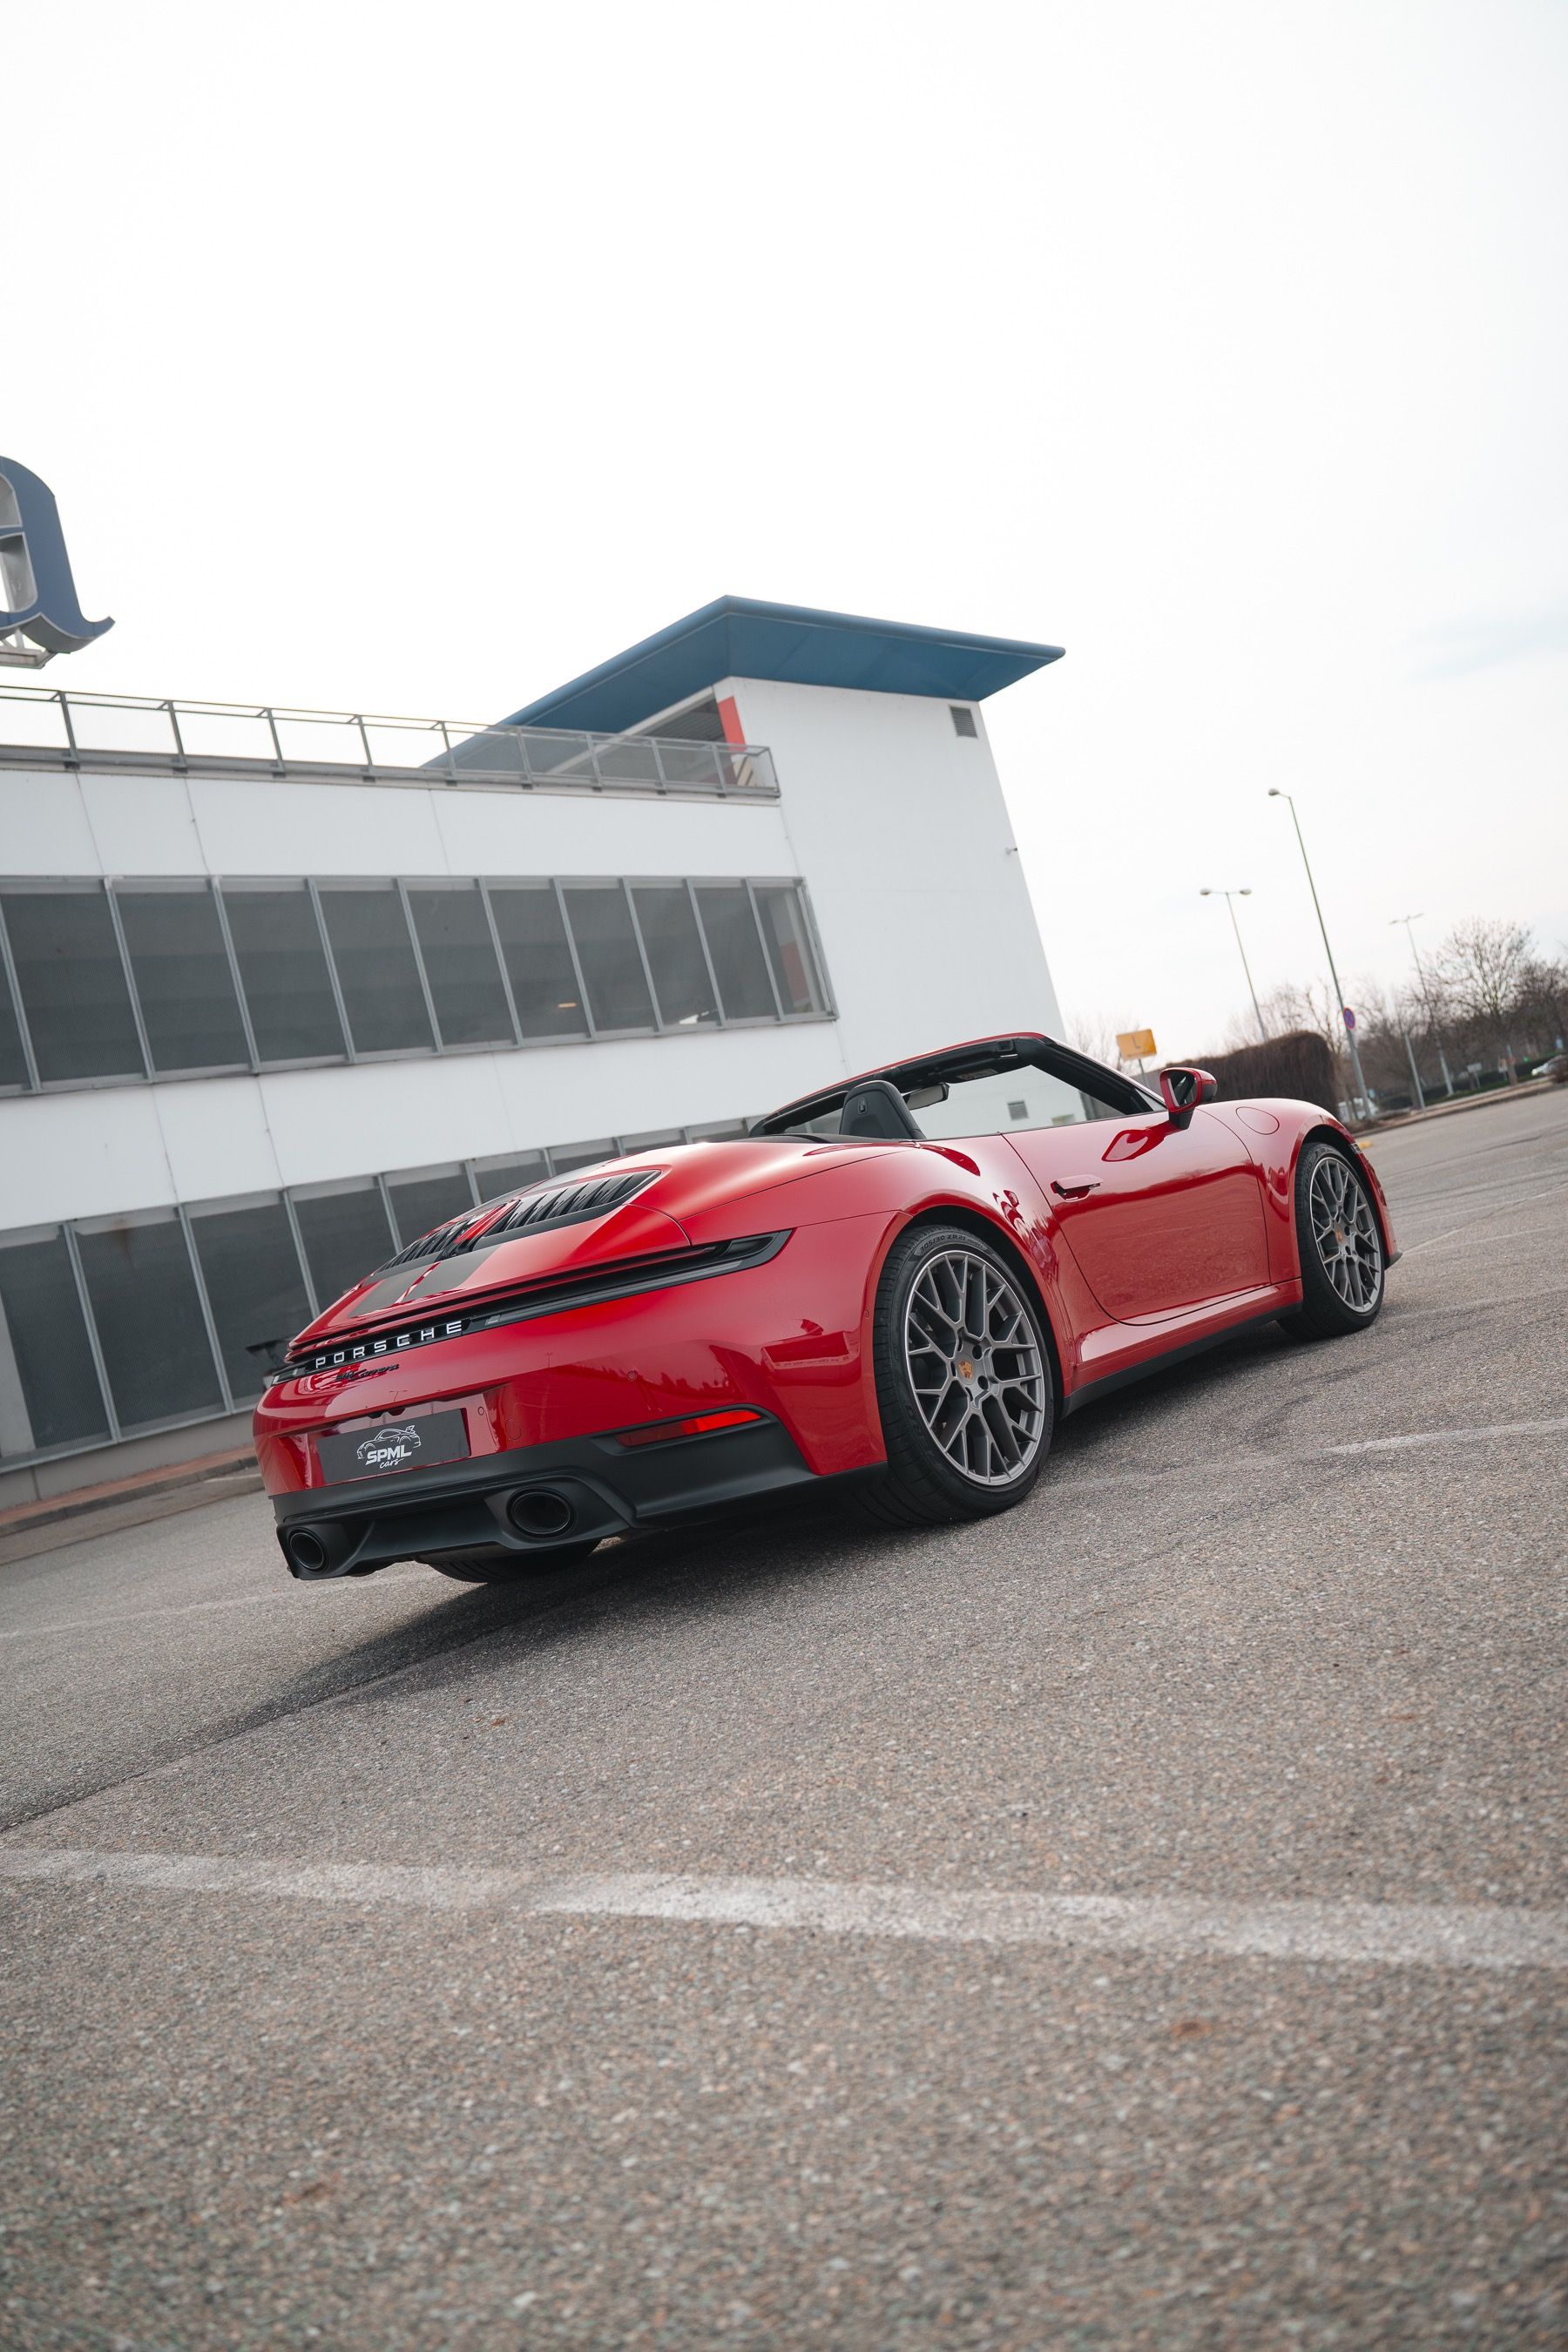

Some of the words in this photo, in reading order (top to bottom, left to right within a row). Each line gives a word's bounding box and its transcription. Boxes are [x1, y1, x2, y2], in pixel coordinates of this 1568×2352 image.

[315, 1321, 462, 1369] PORSCHE
[365, 1444, 412, 1465] SPML
[379, 1457, 405, 1469] cars
